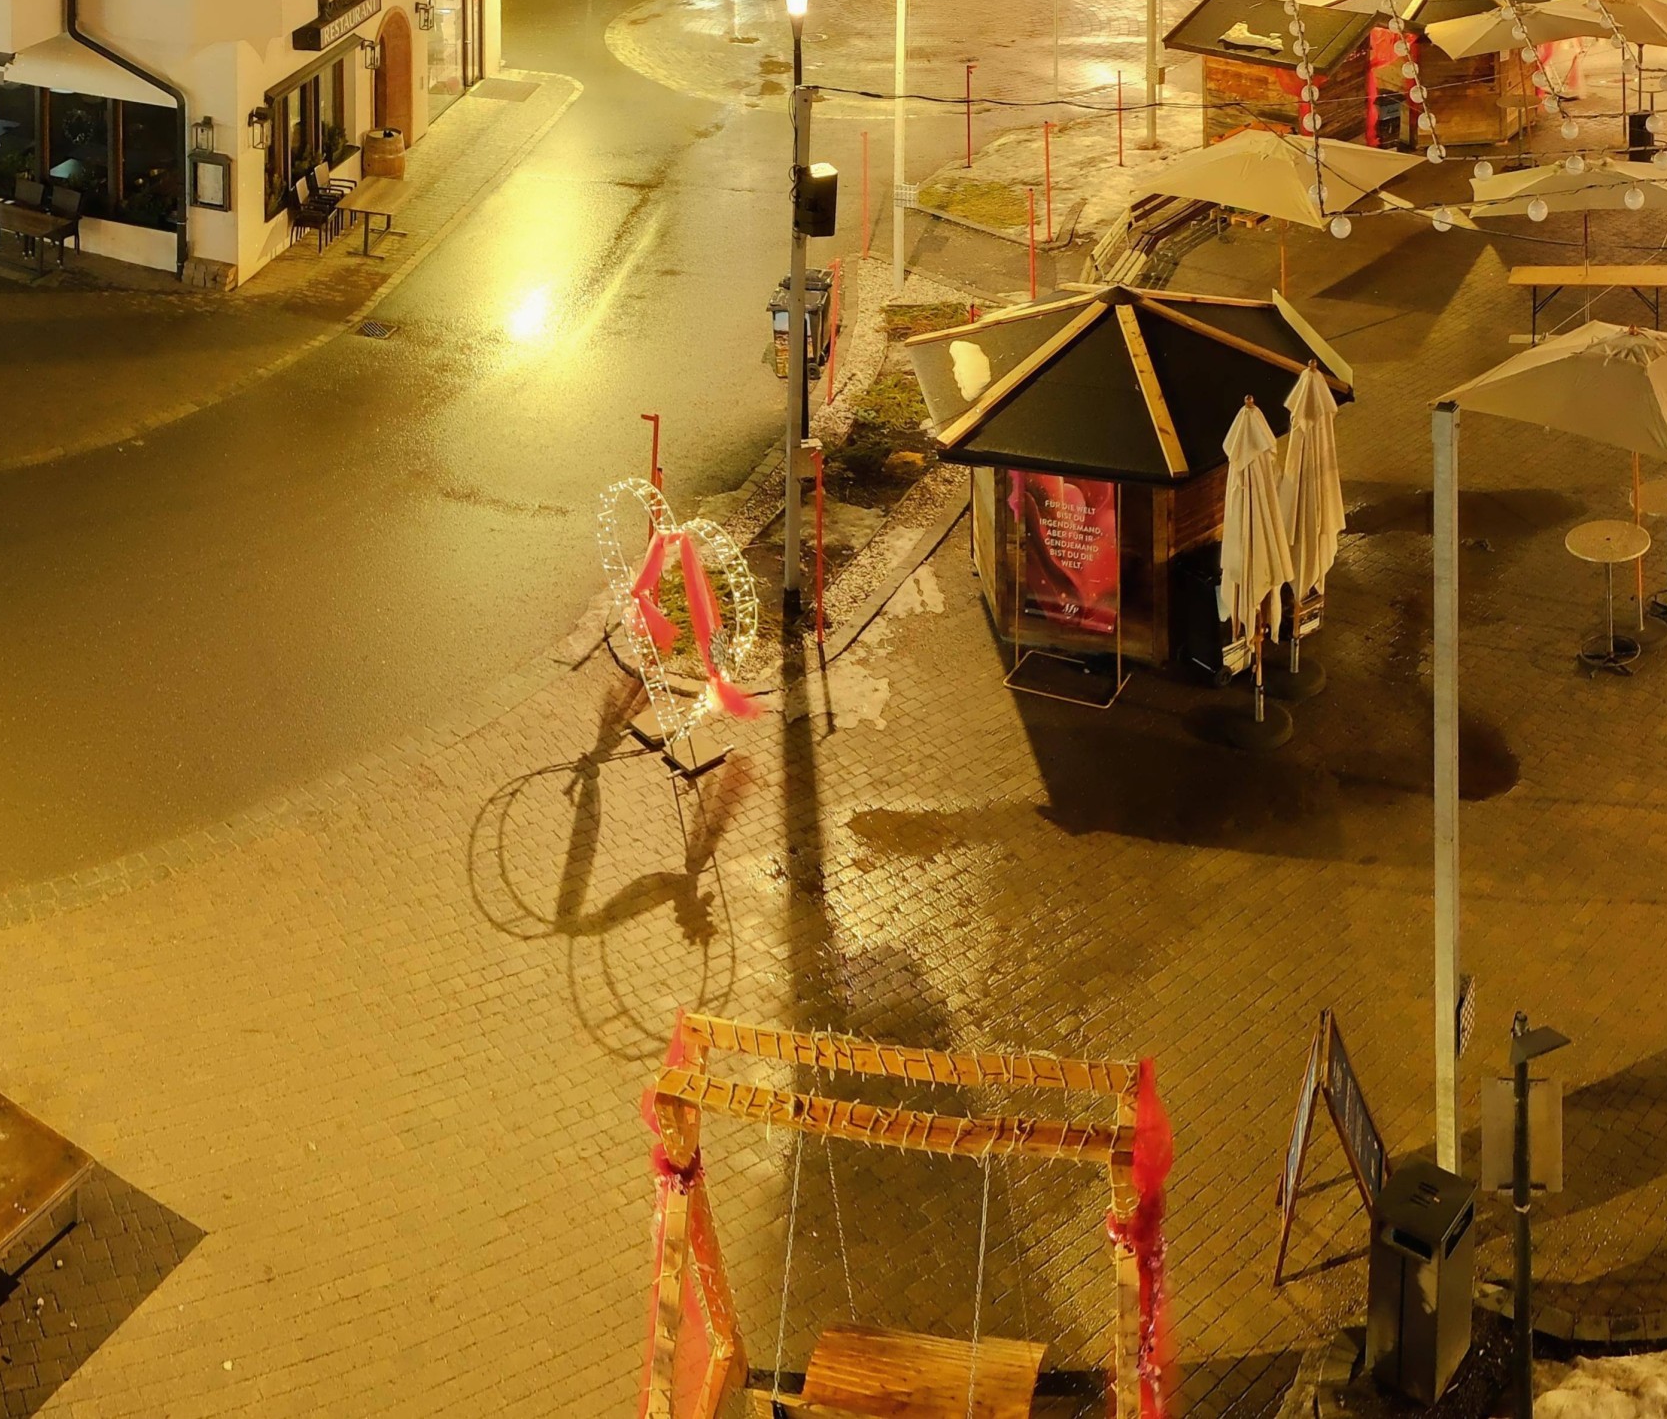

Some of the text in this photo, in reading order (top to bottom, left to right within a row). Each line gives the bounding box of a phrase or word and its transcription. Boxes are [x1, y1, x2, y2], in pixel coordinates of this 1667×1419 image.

[1061, 503, 1074, 512] DIE
[1076, 505, 1096, 515] WELT
[1056, 511, 1085, 523] BIST DU
[1046, 529, 1067, 539] ABER
[1044, 537, 1099, 553] GENDJEMAND
[1049, 548, 1094, 561] BIST DU DIE
